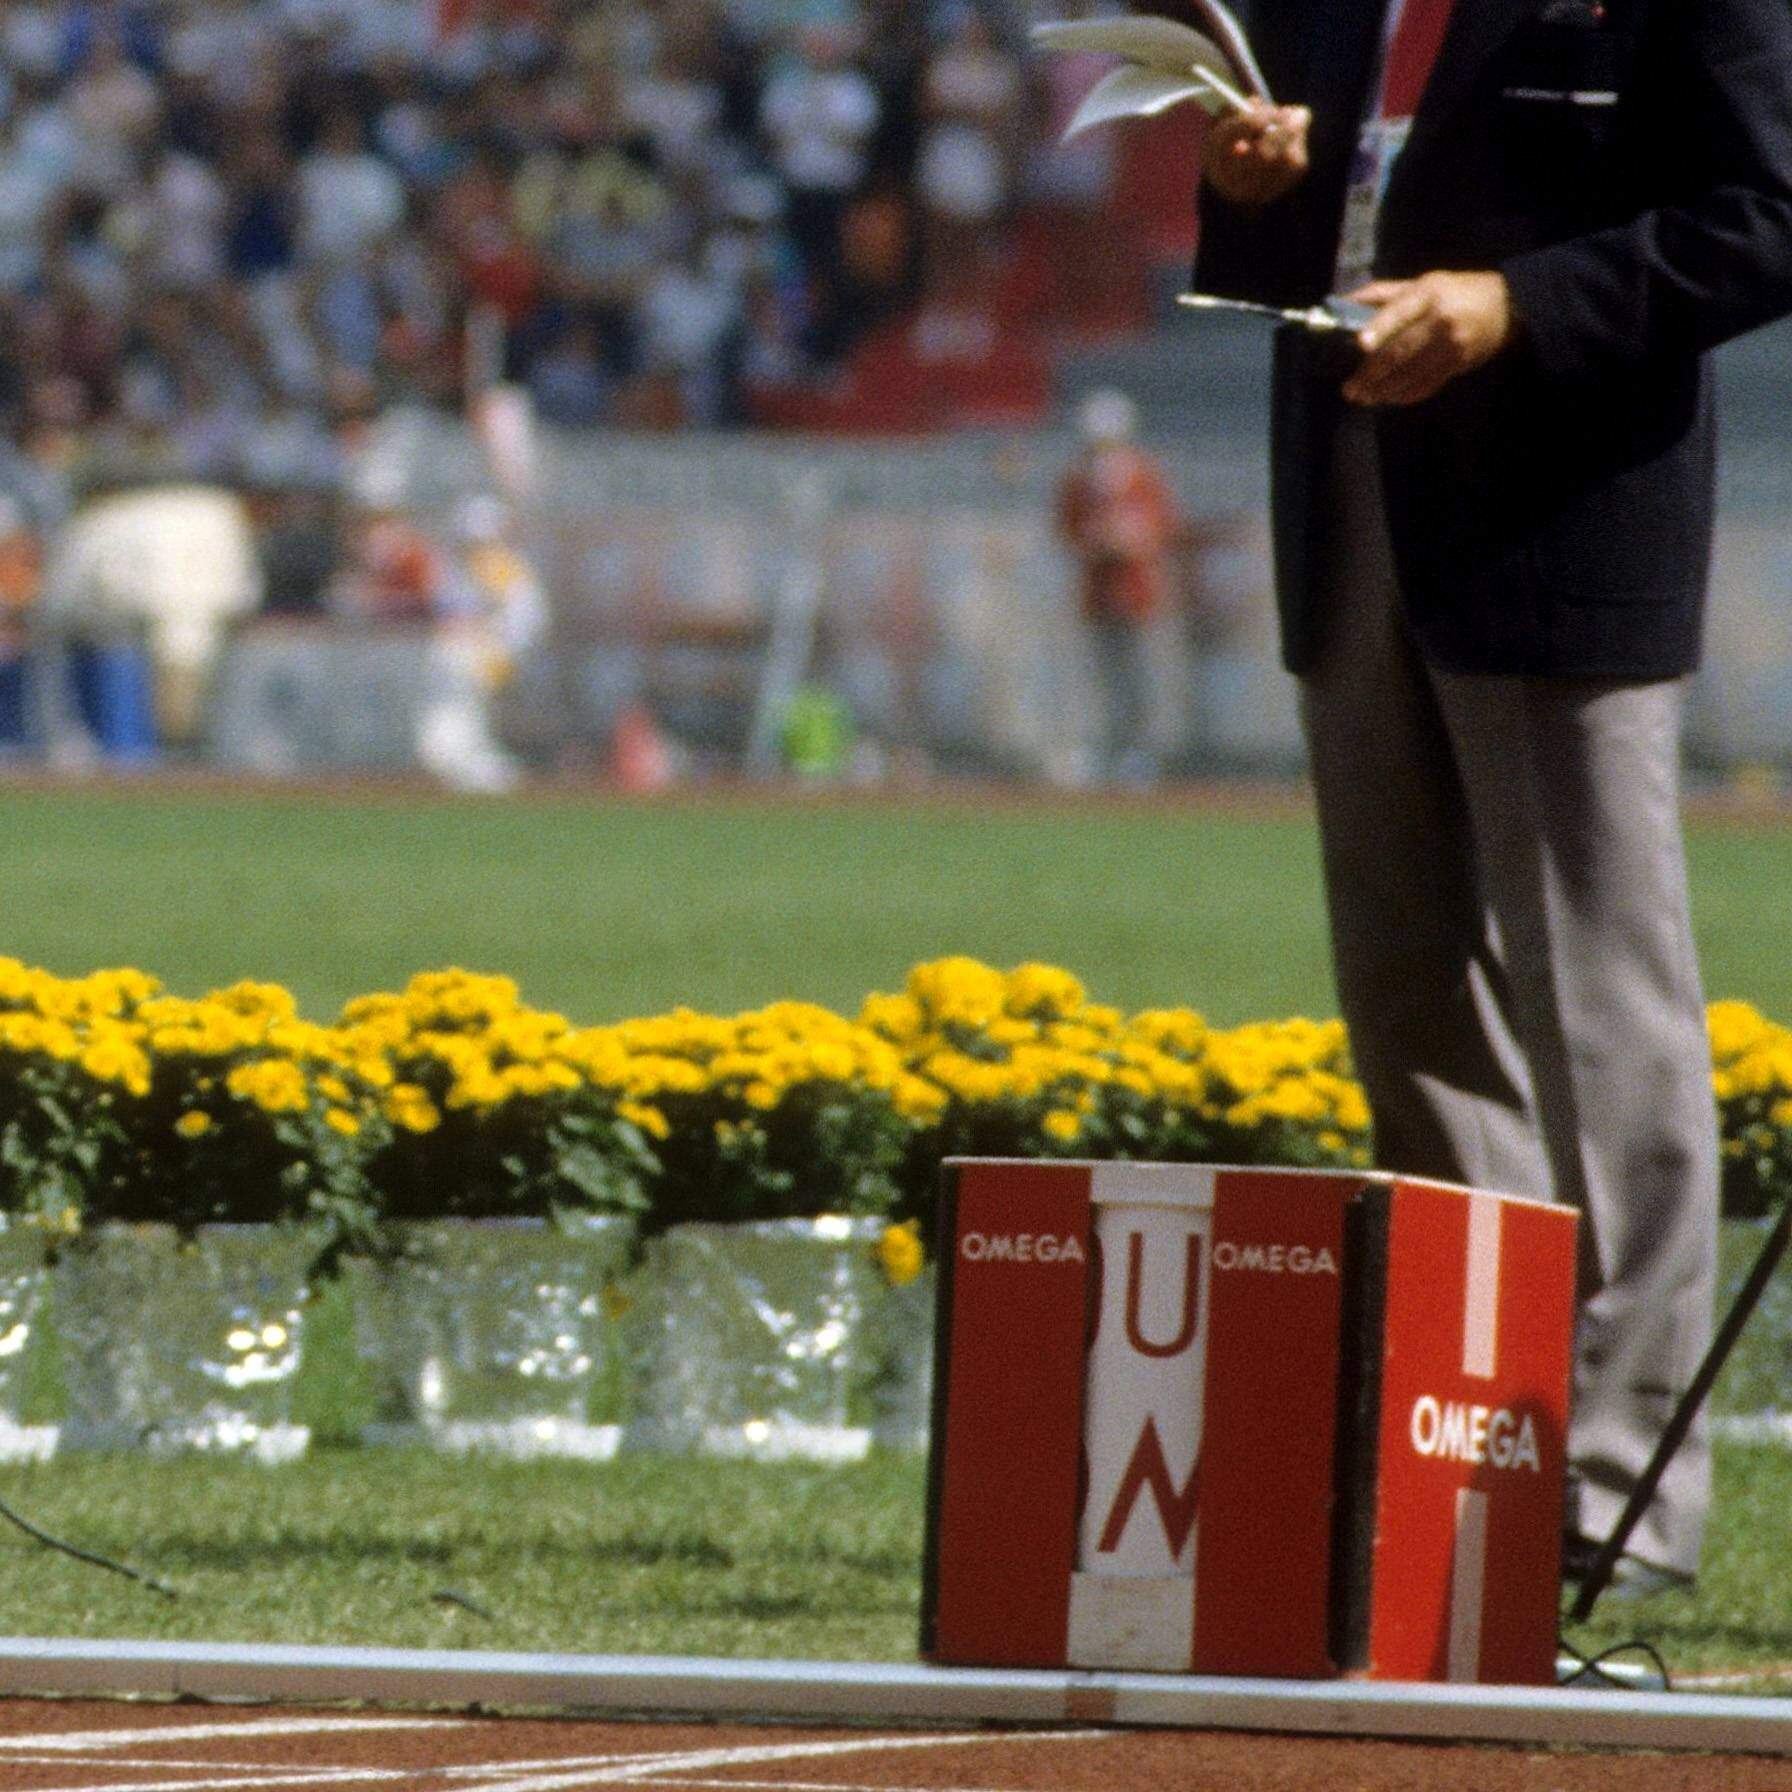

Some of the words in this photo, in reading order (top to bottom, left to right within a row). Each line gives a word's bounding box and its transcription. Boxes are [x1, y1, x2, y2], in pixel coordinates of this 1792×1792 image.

[961, 1233, 1085, 1264] OMEGA
[1215, 1241, 1338, 1275] OMEGA
[1410, 1394, 1541, 1472] OMEGA
